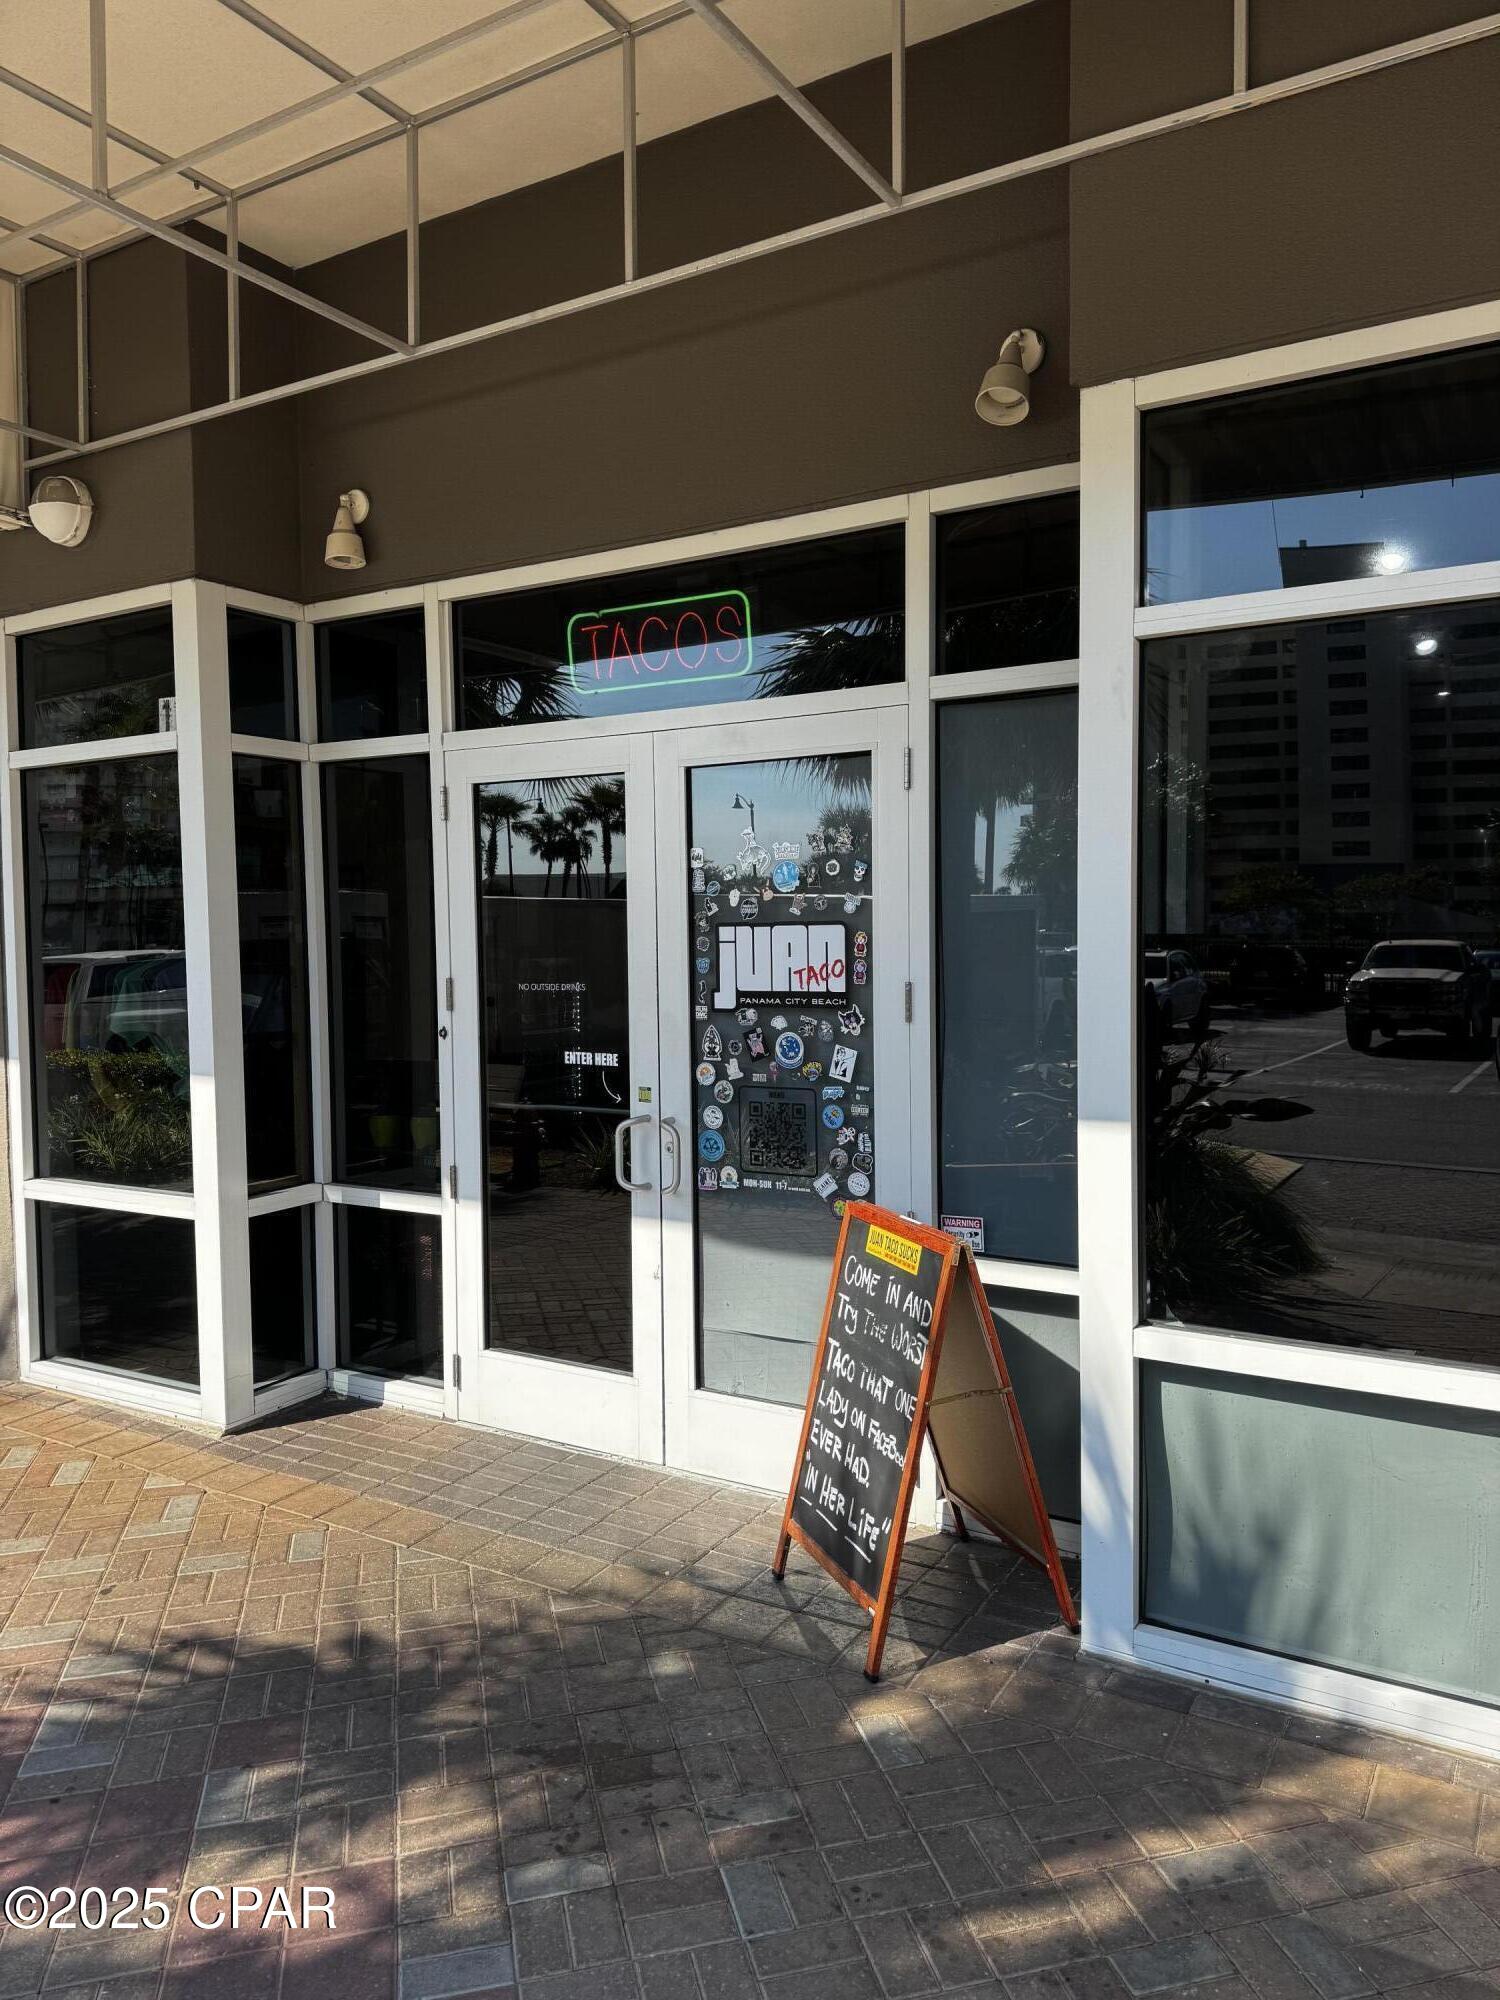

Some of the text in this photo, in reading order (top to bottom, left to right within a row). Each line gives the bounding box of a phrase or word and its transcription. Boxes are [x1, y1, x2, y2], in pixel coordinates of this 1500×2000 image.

[581, 606, 742, 680] TACOS
[518, 982, 586, 991] NO OUTSIDE DRINKS
[793, 959, 845, 990] TACO
[811, 998, 847, 1006] BEACH
[564, 1051, 619, 1067] ENTER HERE
[943, 1218, 980, 1228] WARNING
[884, 1236, 899, 1255] TACO
[899, 1243, 919, 1264] SUCKS
[844, 1255, 881, 1296] COME
[885, 1276, 901, 1309] IN
[902, 1291, 933, 1327] AND
[863, 1308, 889, 1343] THE
[891, 1323, 929, 1371] WORST
[826, 1337, 918, 1422] TACO THAT ONE
[817, 1379, 849, 1428] LADY
[851, 1408, 867, 1436] ON
[810, 1418, 842, 1463] EVER
[819, 1473, 846, 1517] HER
